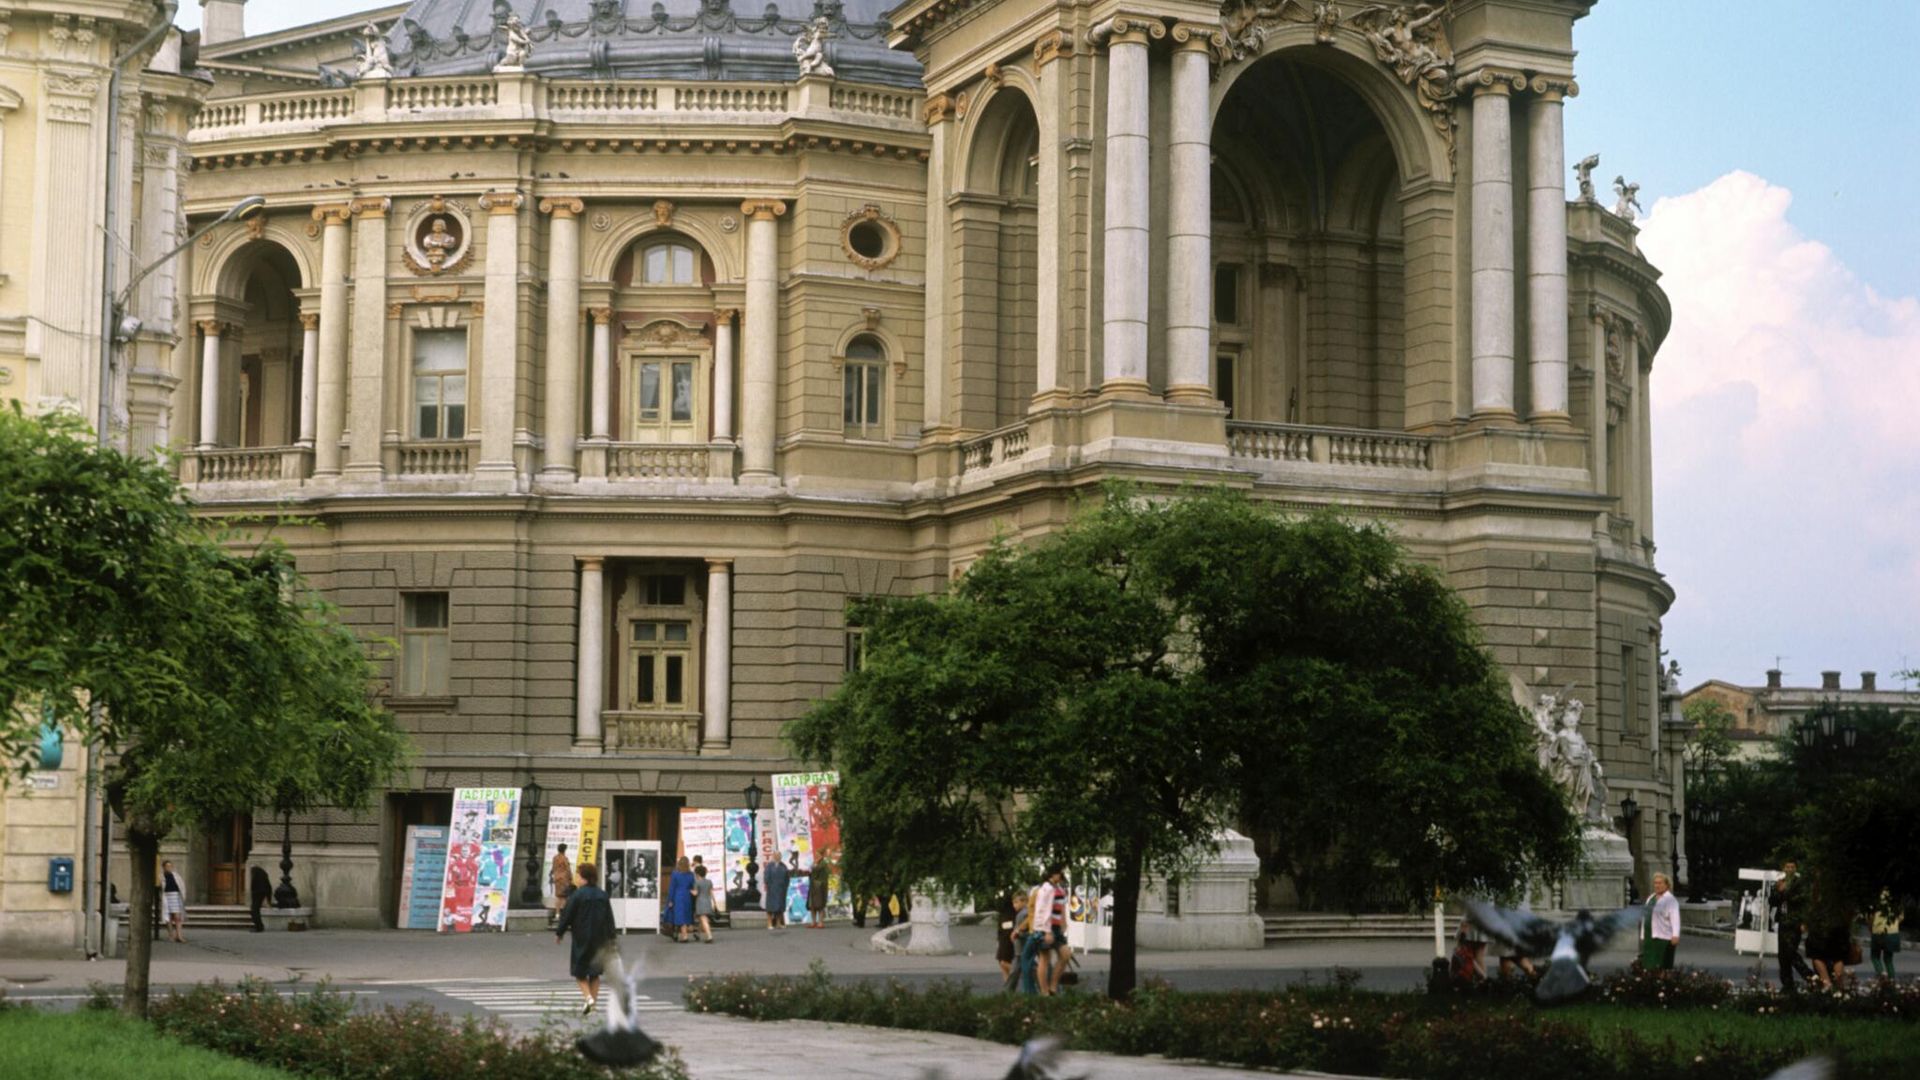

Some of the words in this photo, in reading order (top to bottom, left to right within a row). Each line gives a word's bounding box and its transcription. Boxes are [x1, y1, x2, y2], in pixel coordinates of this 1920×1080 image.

[777, 773, 835, 787] ГАСТРОЛИ
[459, 789, 516, 800] ГАСТРОЛИ
[582, 830, 594, 862] ГАСТ
